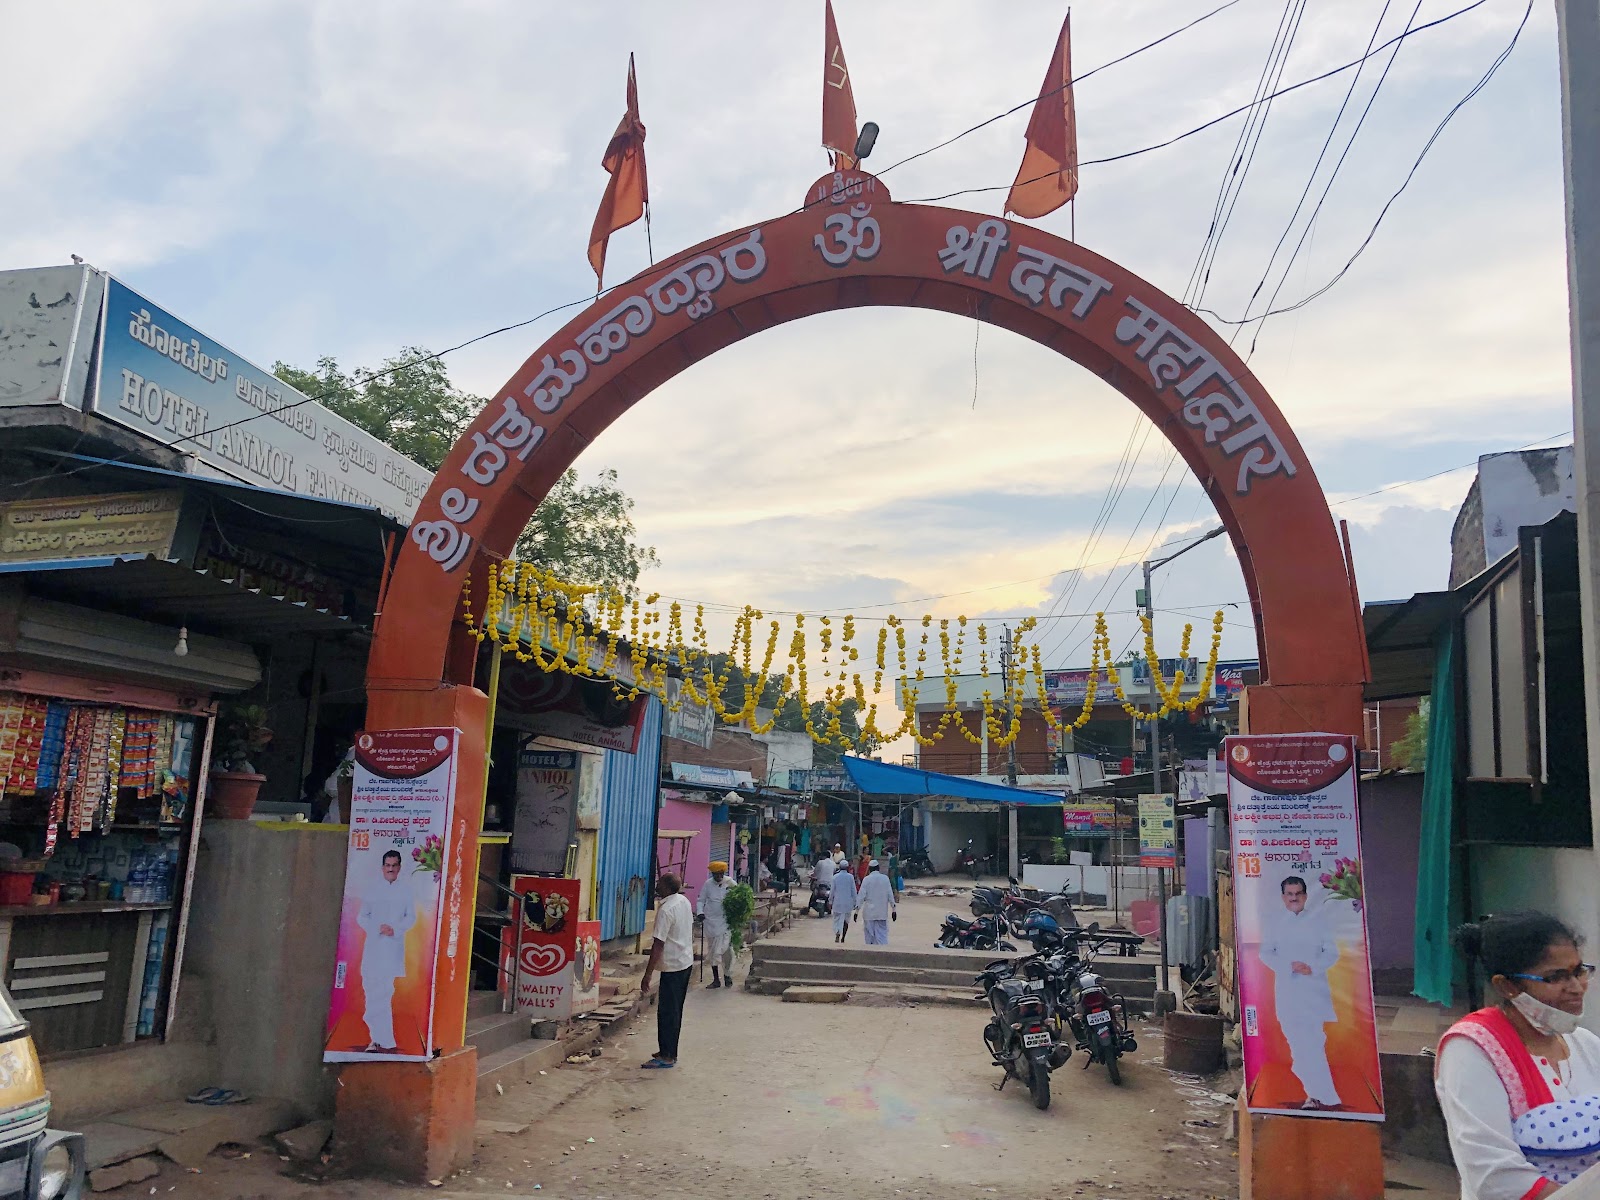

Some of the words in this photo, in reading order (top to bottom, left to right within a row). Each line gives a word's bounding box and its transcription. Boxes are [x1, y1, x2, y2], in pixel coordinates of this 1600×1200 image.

[938, 220, 1009, 281] श्री
[1116, 296, 1297, 494] महाद्वार
[411, 487, 480, 573] ಶ್ರೀ
[524, 229, 767, 413] ಮಹಾದ್ವಾರ
[119, 368, 212, 450] HOTEL
[216, 421, 298, 492] ANMOL
[1220, 668, 1243, 682] Yas
[572, 730, 595, 743] HOTEL
[598, 737, 626, 749] ANMOL
[521, 755, 556, 765] HOTEL
[519, 984, 564, 997] WALITY
[518, 997, 556, 1009] WALL'S
